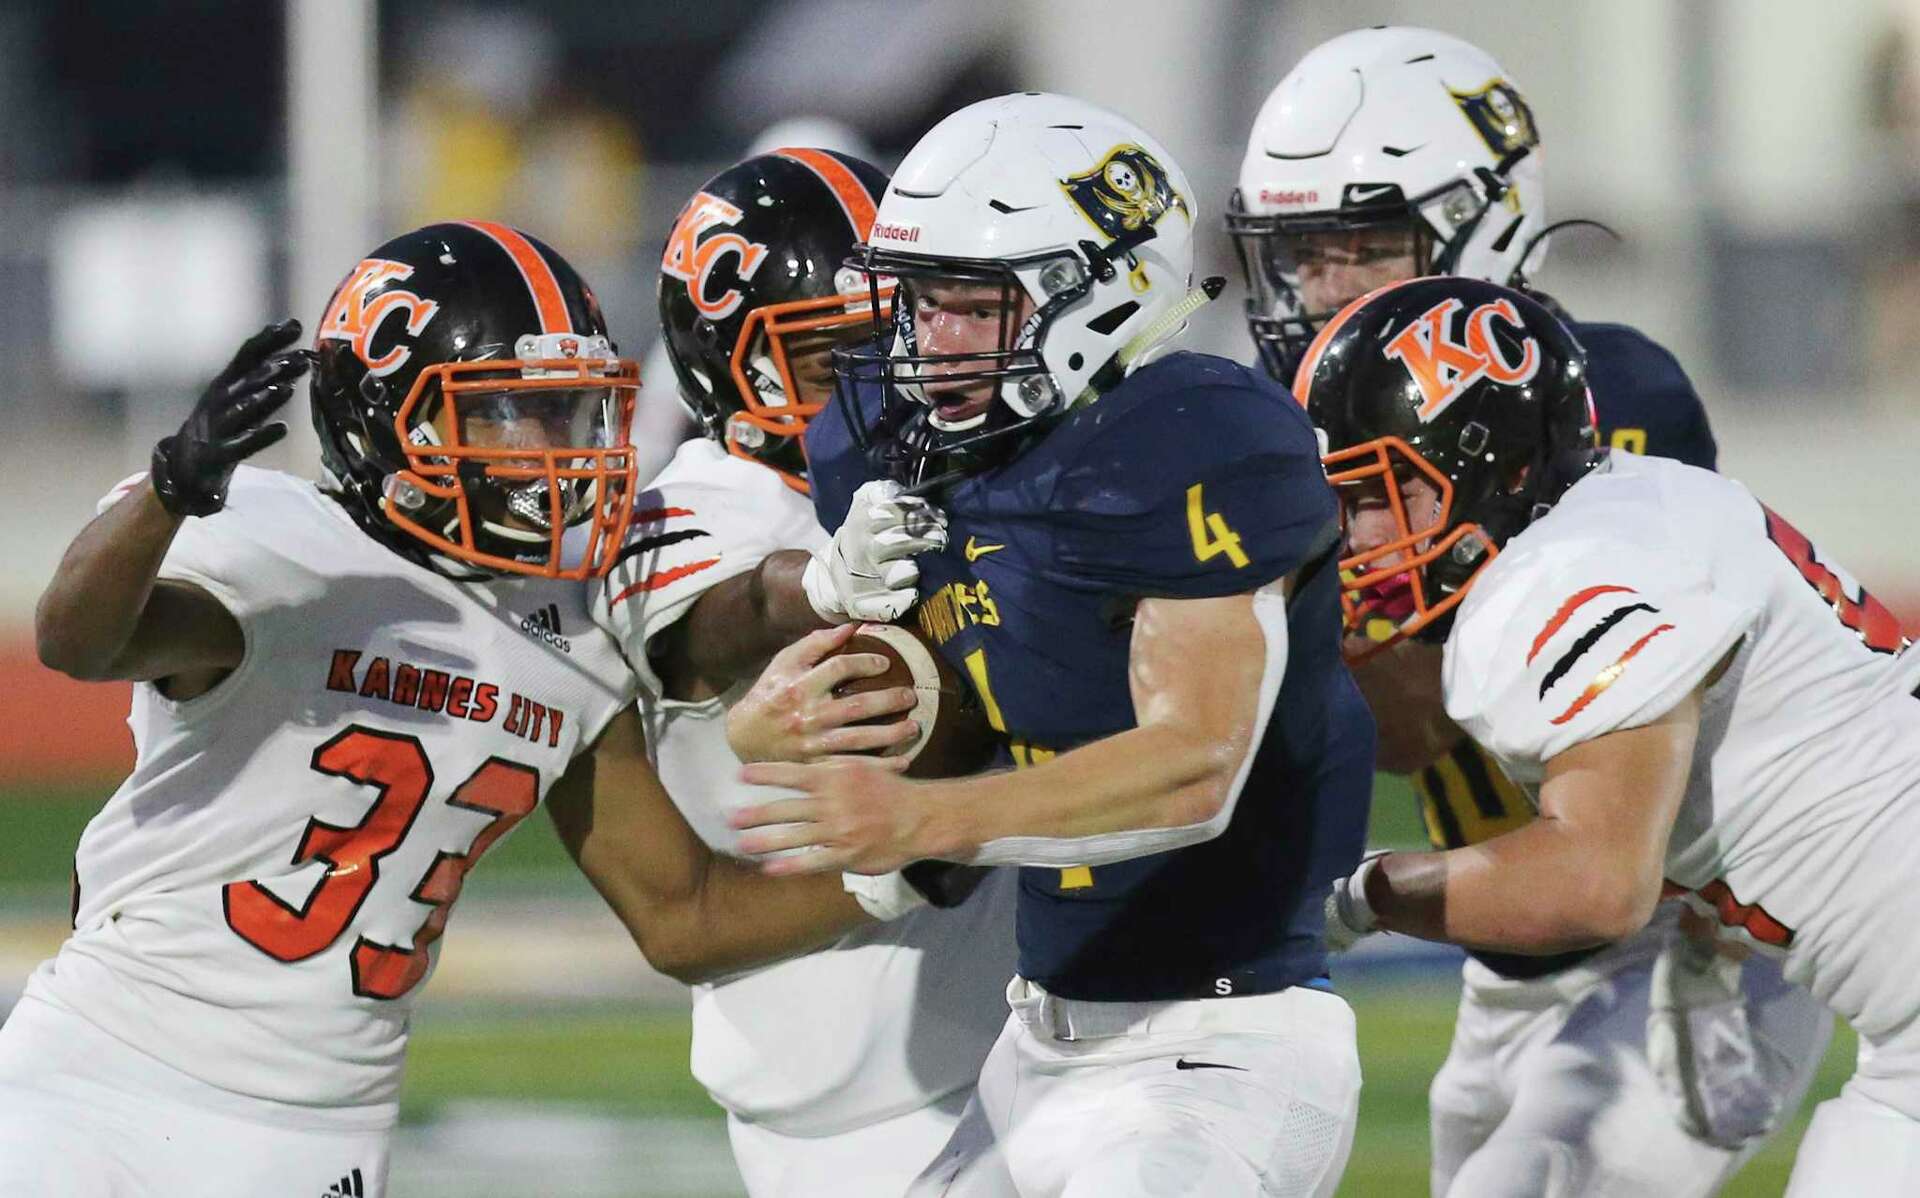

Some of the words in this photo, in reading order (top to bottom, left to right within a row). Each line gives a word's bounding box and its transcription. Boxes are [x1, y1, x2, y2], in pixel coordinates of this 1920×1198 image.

[873, 222, 921, 243] Riddell
[1259, 188, 1319, 206] Riddell
[661, 190, 771, 321] KC
[318, 257, 441, 379] KC
[1382, 297, 1542, 425] KC
[1185, 482, 1251, 569] 4
[520, 618, 571, 654] adidas
[326, 648, 500, 724] KARNES
[502, 692, 564, 748] CITY
[222, 722, 540, 1001] 33
[1215, 977, 1233, 996] S
